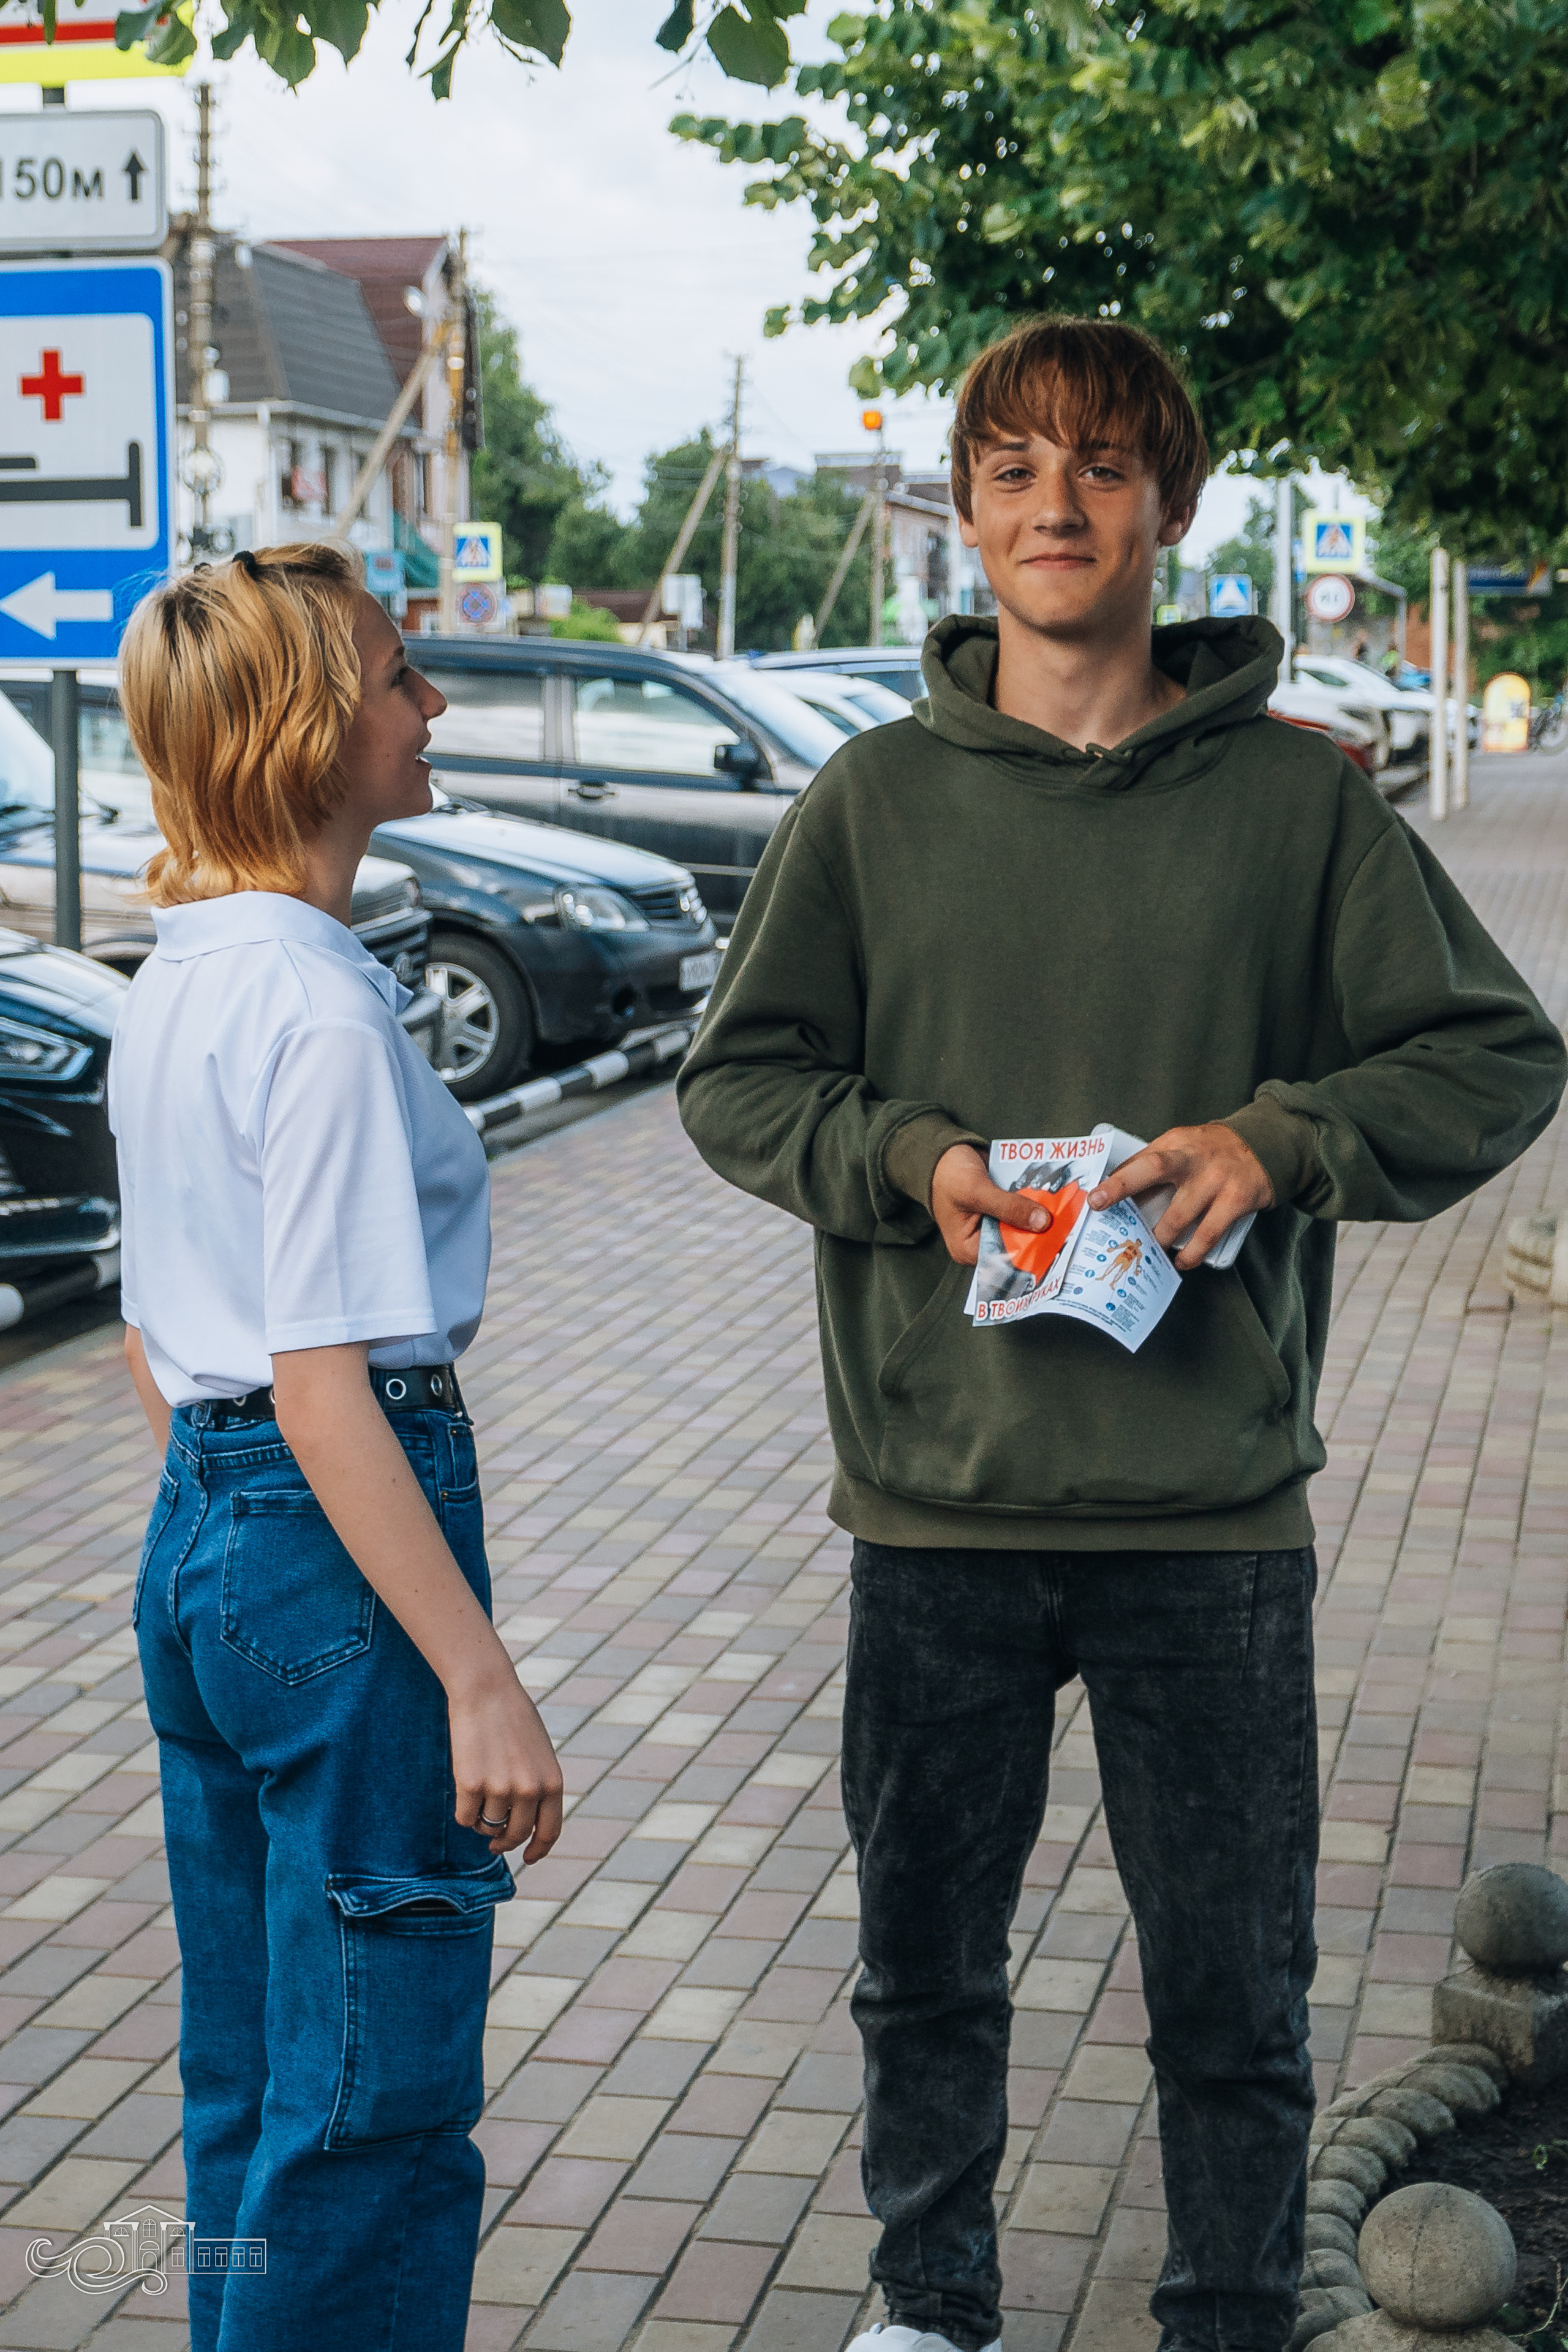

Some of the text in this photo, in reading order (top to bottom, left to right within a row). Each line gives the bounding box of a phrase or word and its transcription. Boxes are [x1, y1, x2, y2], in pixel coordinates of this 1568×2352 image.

[1001, 1137, 1105, 1160] ТВОЯ ЖИЗНЬ
[978, 1304, 986, 1318] В
[992, 1297, 1029, 1317] ТВОИХ
[1030, 1276, 1061, 1304] РУКАХ
